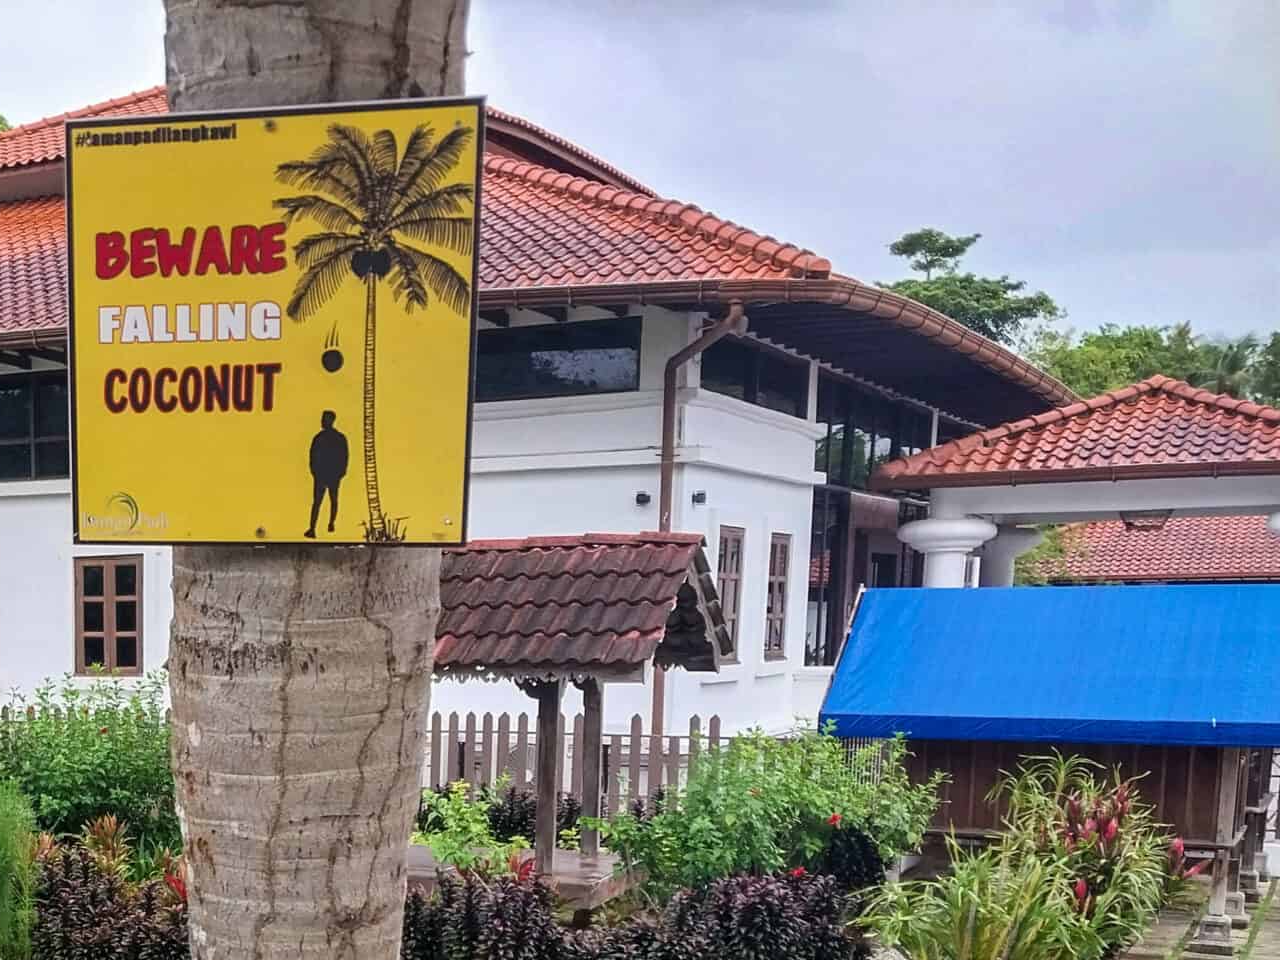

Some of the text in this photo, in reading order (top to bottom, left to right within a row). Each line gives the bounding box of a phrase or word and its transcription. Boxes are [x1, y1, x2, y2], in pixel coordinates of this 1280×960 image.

[95, 222, 287, 279] BEWARE
[98, 301, 281, 344] FALLING
[104, 363, 282, 413] COCONUT
